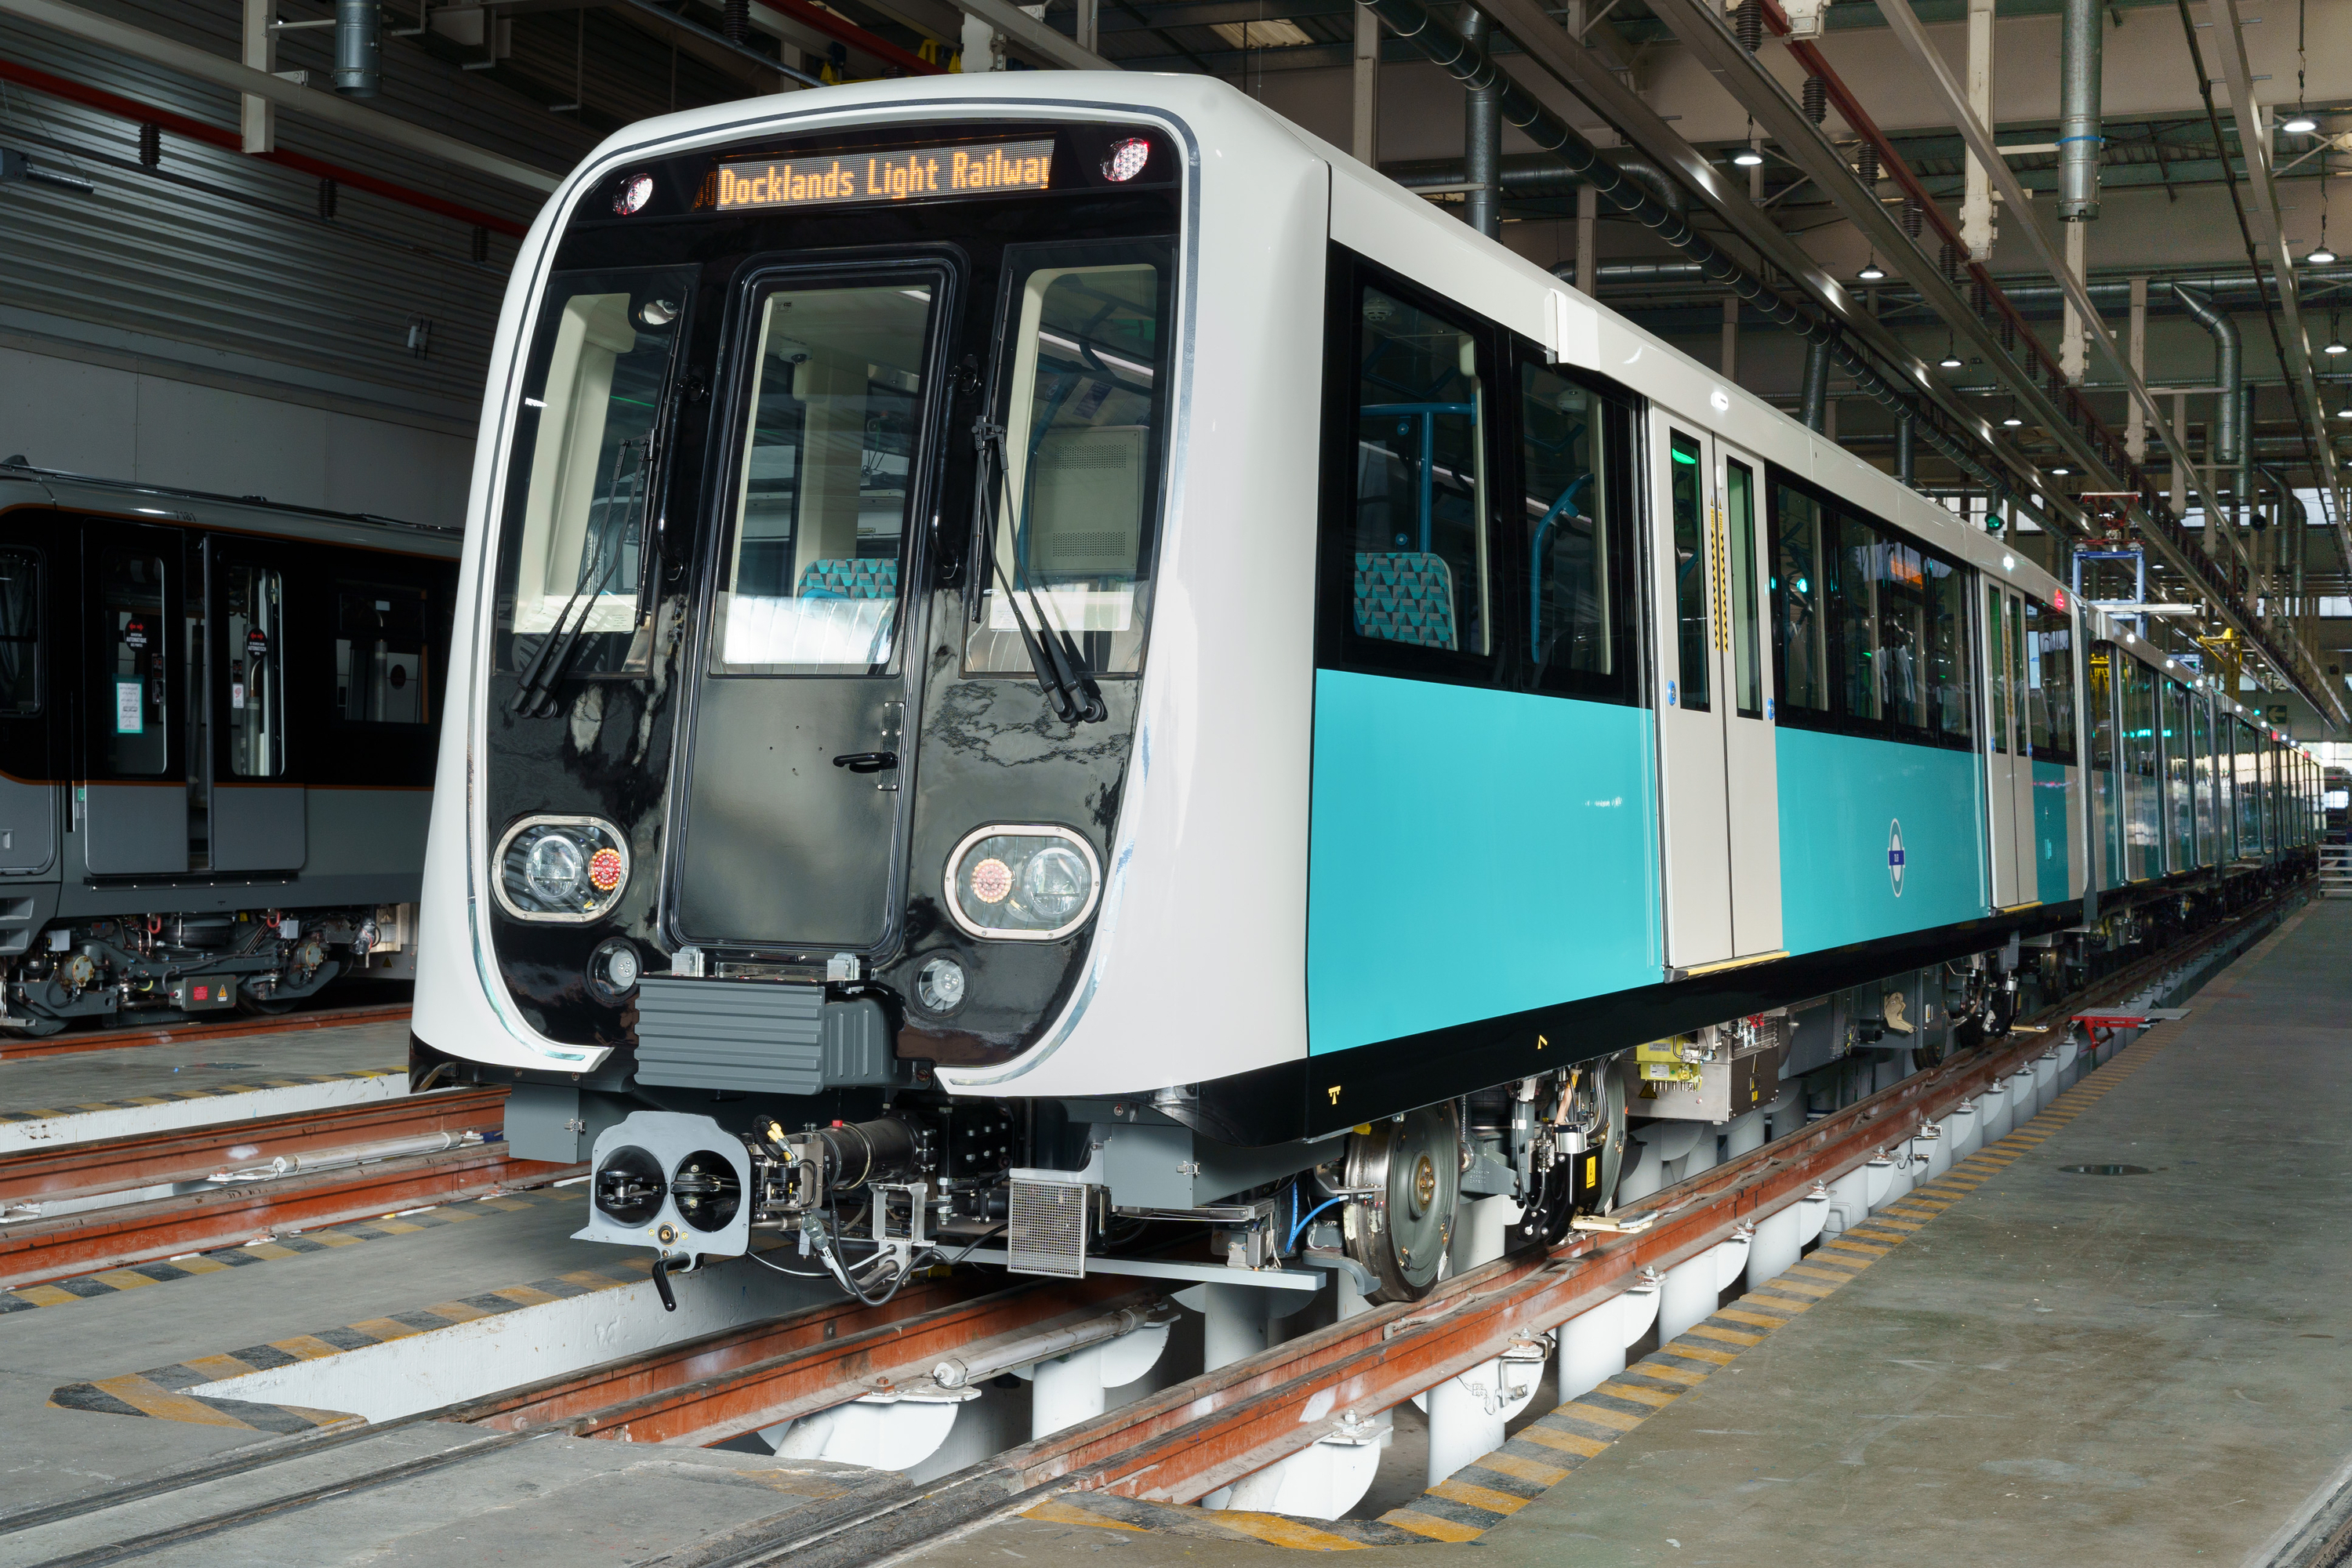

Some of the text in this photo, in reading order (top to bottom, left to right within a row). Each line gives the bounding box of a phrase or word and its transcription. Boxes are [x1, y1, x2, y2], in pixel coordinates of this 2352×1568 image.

[719, 162, 854, 205] Docklands
[867, 155, 938, 199] Light
[172, 510, 196, 521] 7181
